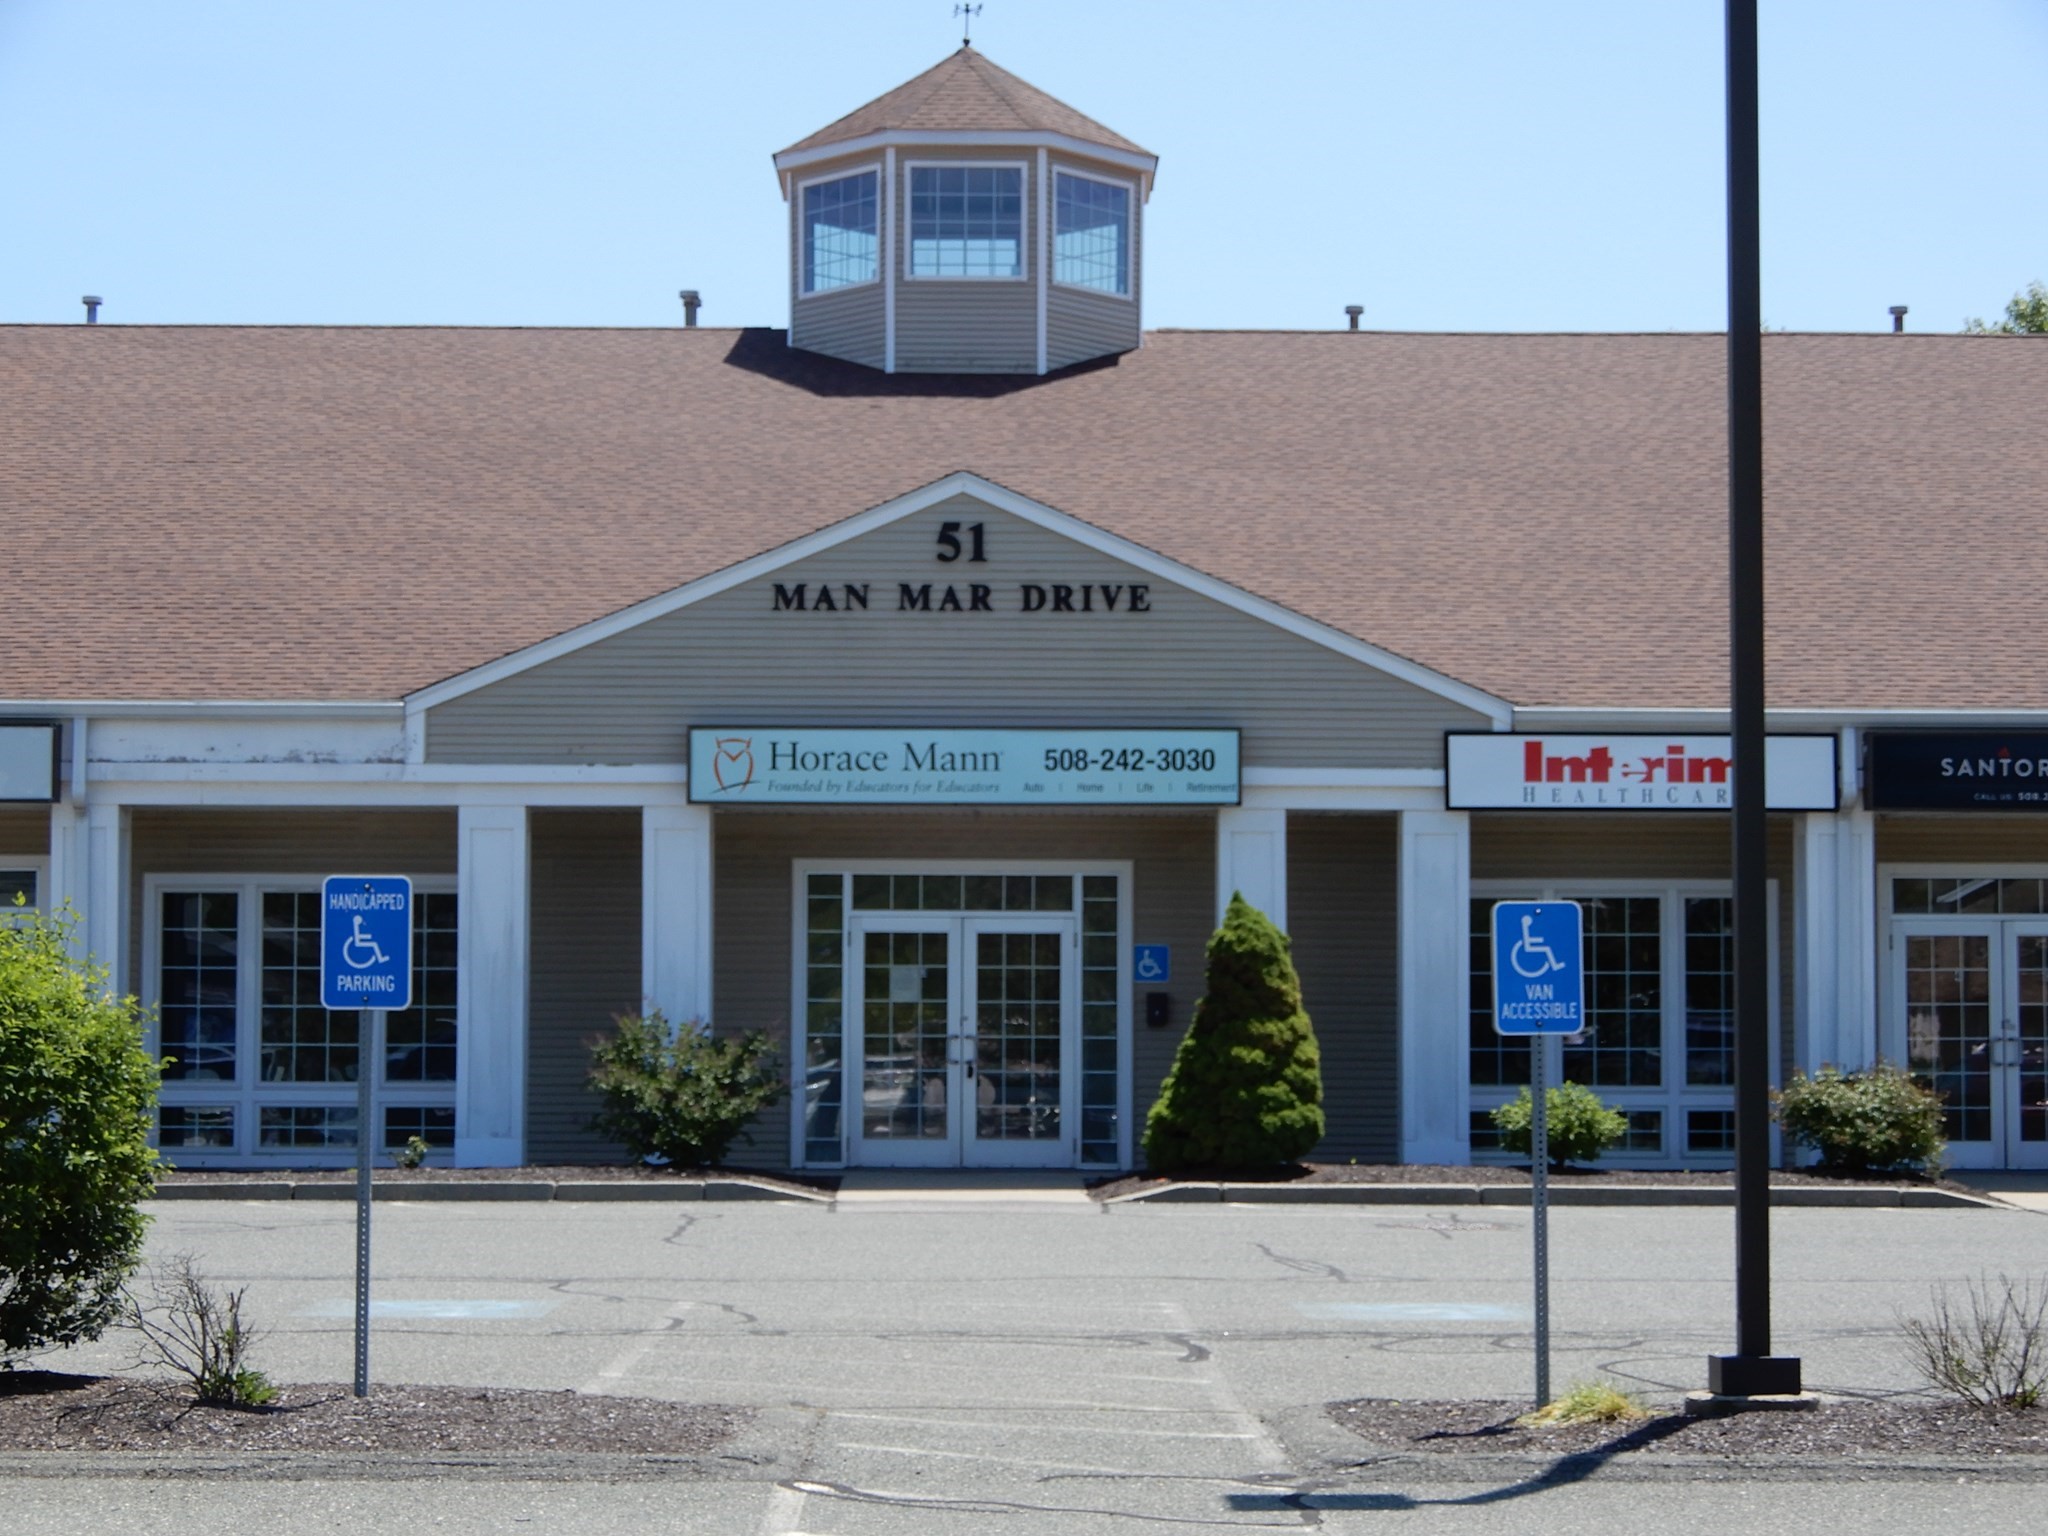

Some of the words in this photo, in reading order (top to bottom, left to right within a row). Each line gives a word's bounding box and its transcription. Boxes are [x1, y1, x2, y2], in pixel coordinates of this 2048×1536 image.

[937, 522, 987, 562] 51
[772, 584, 870, 612] MAN
[898, 584, 993, 612] MAR
[1021, 584, 1151, 612] DRIVE
[769, 741, 889, 772] Horace
[902, 741, 1001, 772] Mann
[1044, 749, 1216, 771] 508-242-3030
[767, 779, 822, 793] Founded
[826, 779, 842, 795] by
[845, 779, 910, 793] Educators
[912, 779, 932, 796] for
[936, 779, 1000, 794] Educators
[1023, 782, 1044, 794] Auto
[1077, 782, 1104, 793] Home
[1136, 782, 1154, 793] Life
[1186, 782, 1237, 793] Retirement
[1523, 786, 1728, 804] HEALTHCAR
[329, 893, 405, 910] HANDICAPPED
[337, 974, 396, 992] PARKING
[1525, 984, 1554, 1001] VAN
[1501, 1002, 1578, 1020] ACCESSIBLE
